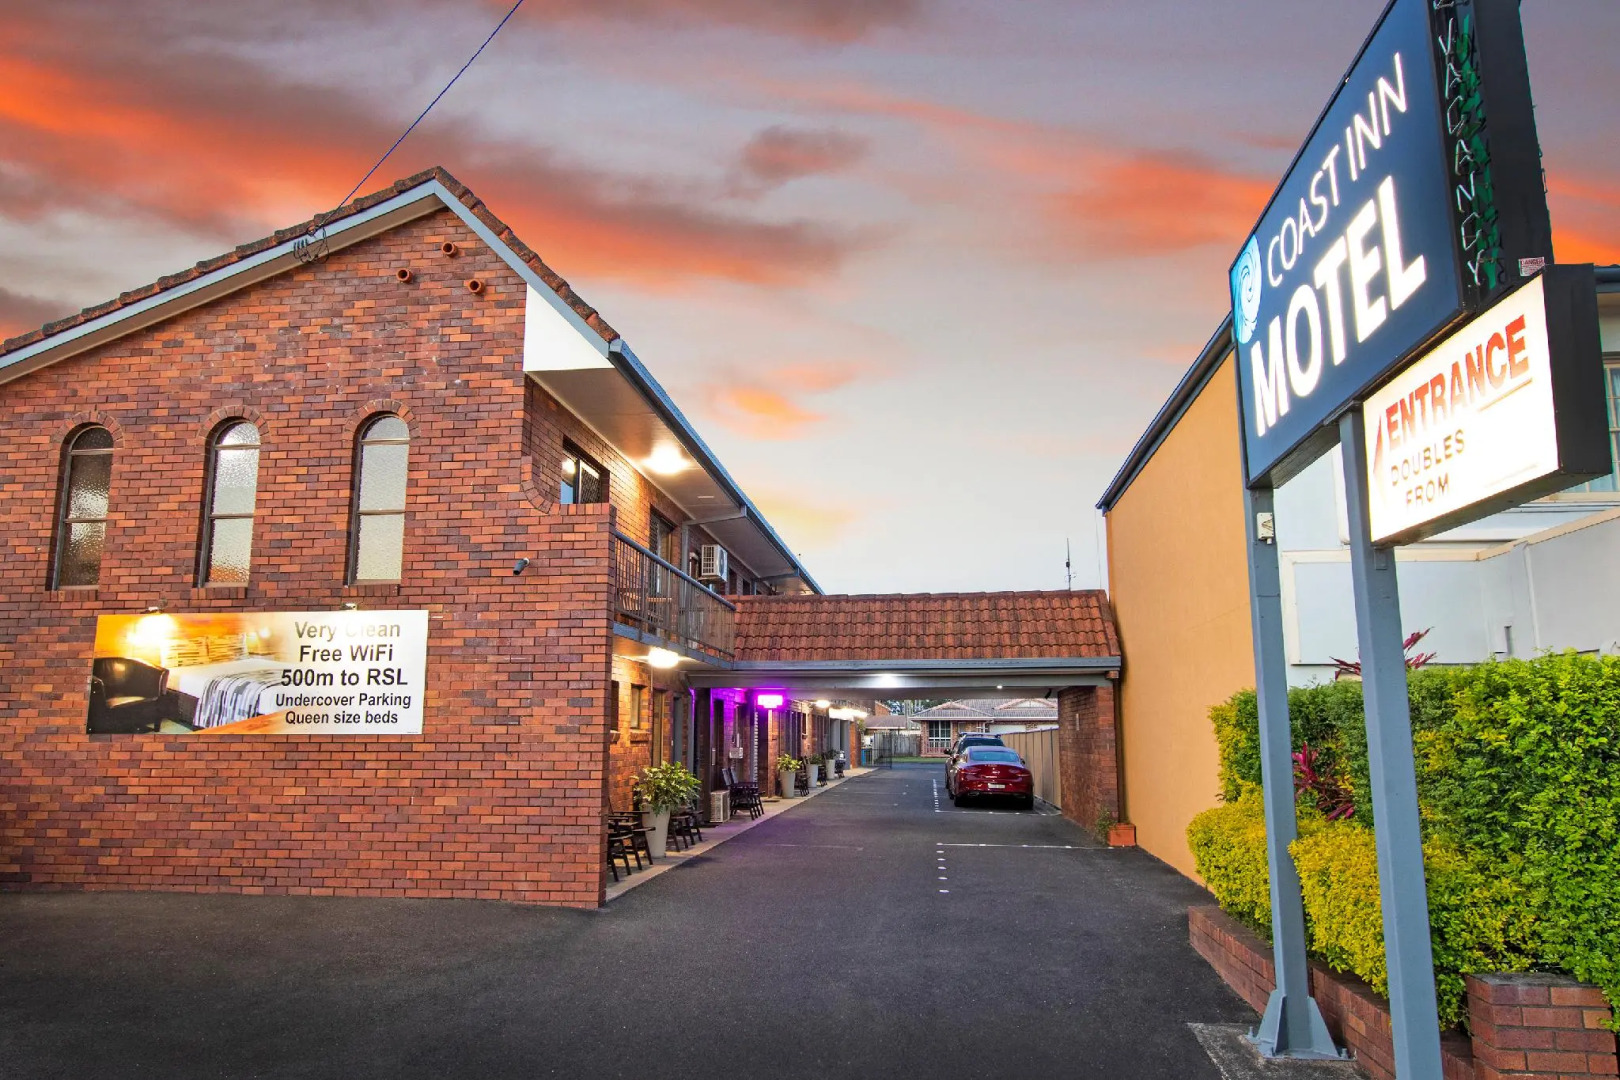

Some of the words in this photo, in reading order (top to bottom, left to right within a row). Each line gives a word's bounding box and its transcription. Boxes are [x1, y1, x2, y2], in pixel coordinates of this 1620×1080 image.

[1268, 143, 1340, 287] COAST
[1346, 51, 1408, 182] INN
[1438, 17, 1485, 286] VACANCY
[1250, 175, 1428, 438] MOTEL
[1385, 314, 1530, 450] ENTRANCE
[1391, 429, 1465, 487] DOUBLES
[1405, 472, 1450, 507] FROM
[295, 621, 337, 642] Very
[300, 645, 342, 662] Free
[350, 644, 393, 661] WiFi
[281, 668, 333, 686] 500m
[341, 669, 360, 686] to
[367, 667, 408, 685] RSL
[276, 693, 355, 706] Undercover
[359, 692, 411, 709] Parking
[285, 711, 329, 724] Queen
[334, 710, 360, 724] size
[365, 710, 398, 724] beds
